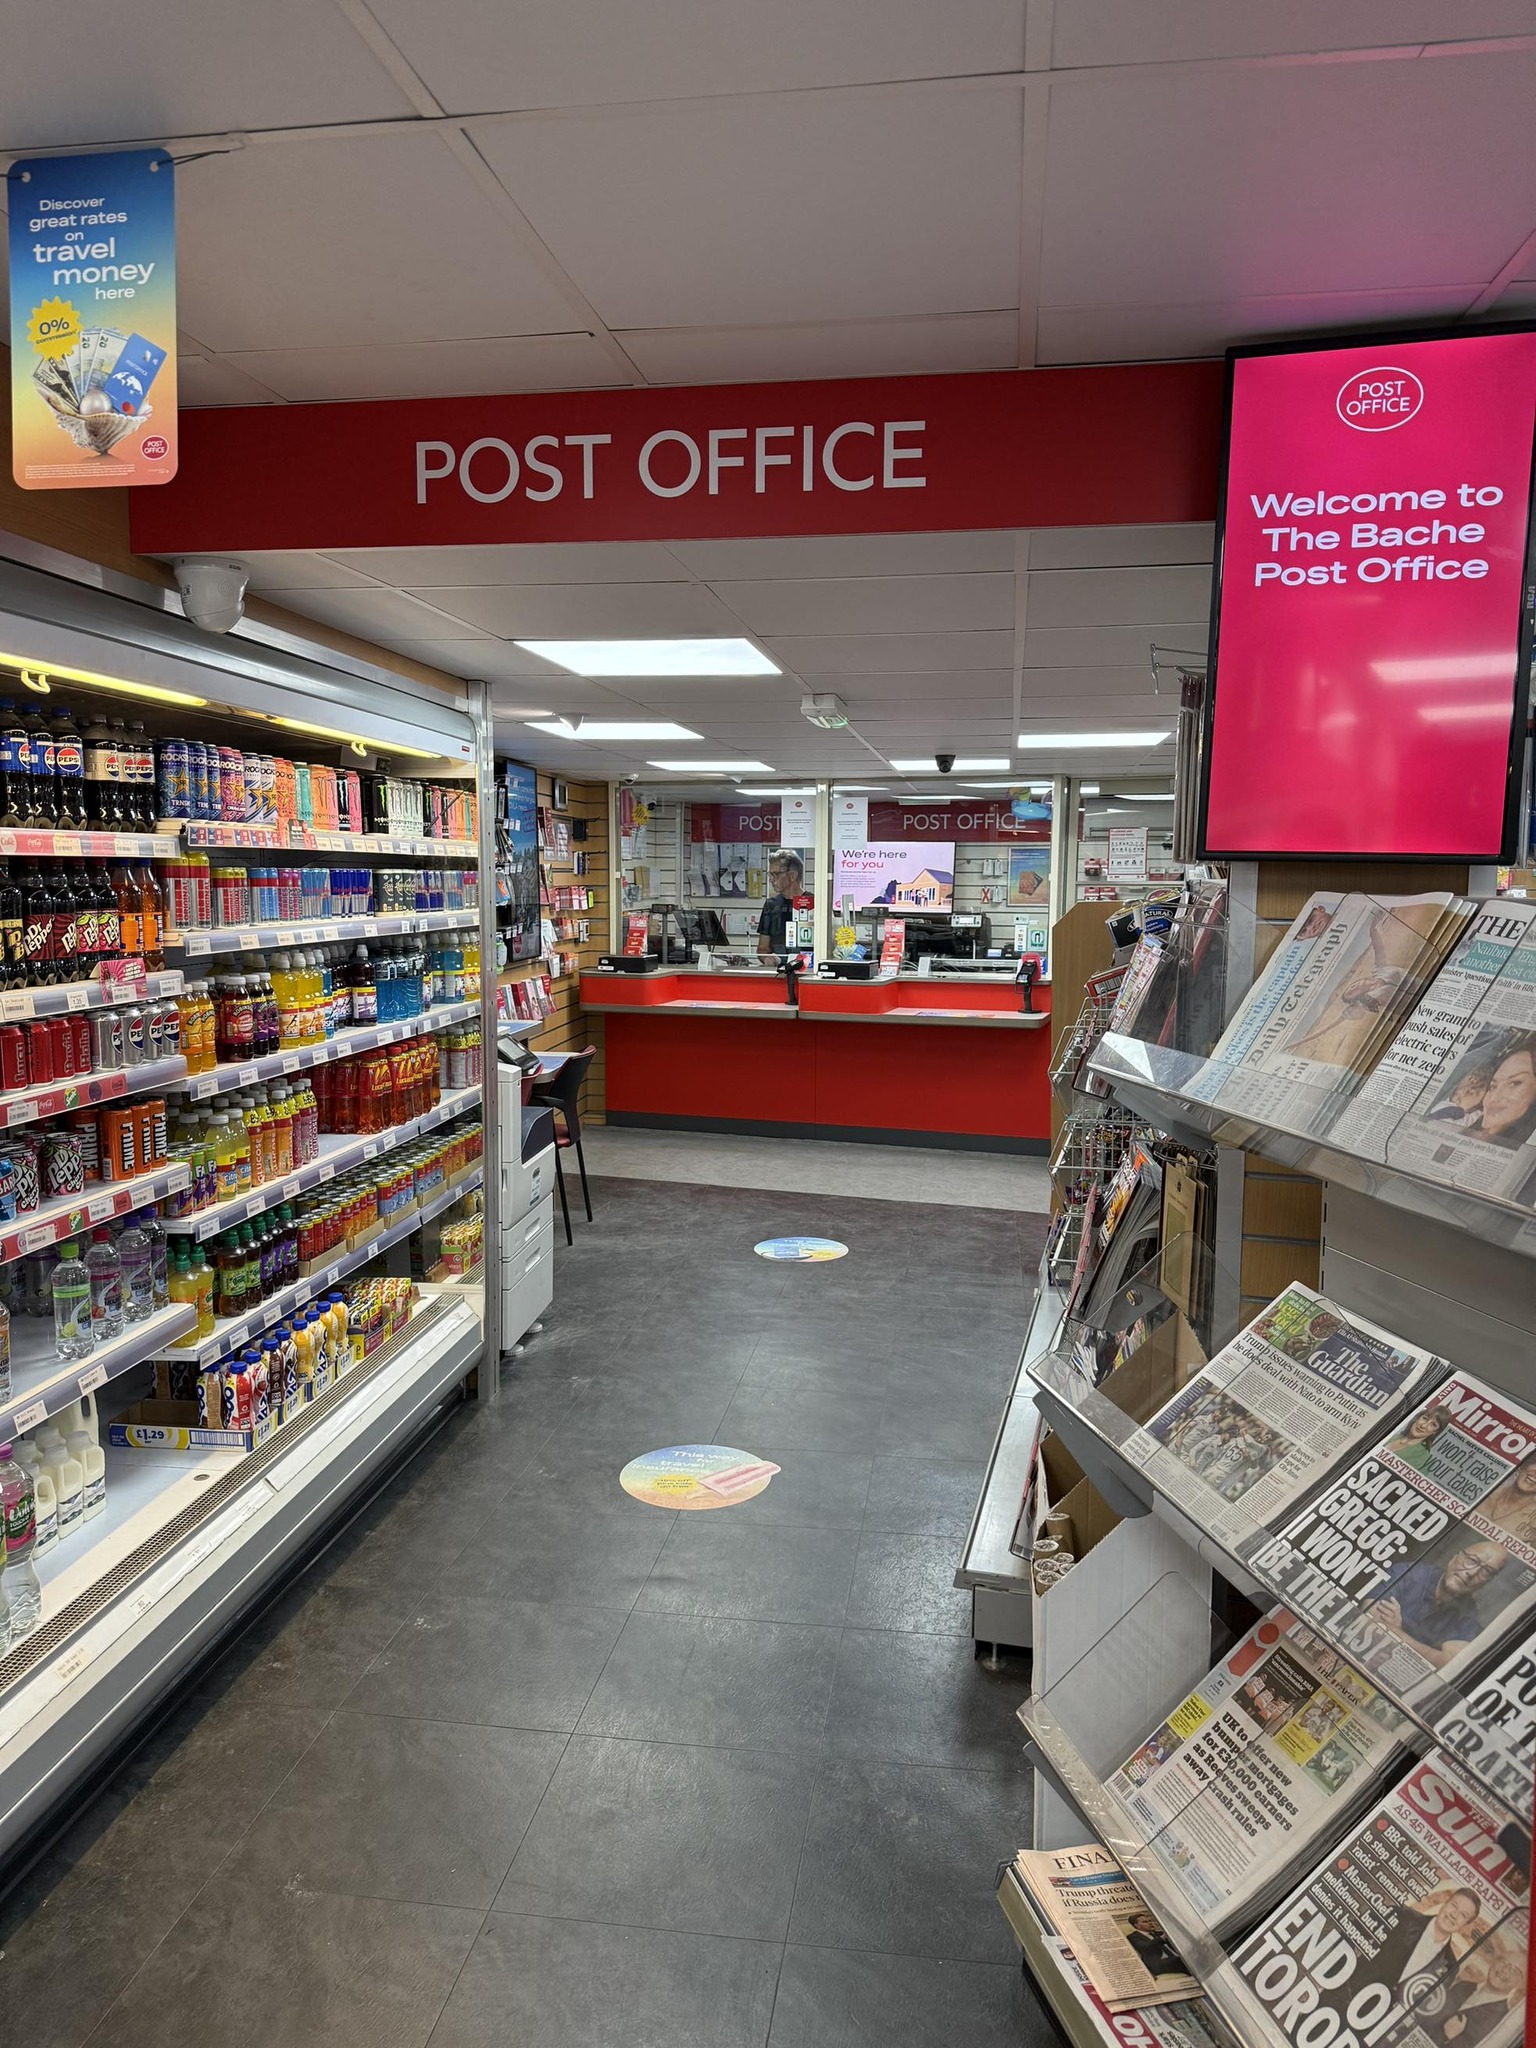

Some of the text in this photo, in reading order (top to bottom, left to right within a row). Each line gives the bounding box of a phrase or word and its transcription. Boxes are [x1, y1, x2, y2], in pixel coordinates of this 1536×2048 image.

[29, 211, 128, 231] great rates
[39, 198, 105, 211] Discover
[33, 238, 116, 263] travel
[64, 231, 84, 241] on
[53, 263, 155, 286] money
[95, 286, 135, 300] here
[39, 317, 70, 336] 0%
[1359, 380, 1406, 398] POST
[1346, 397, 1410, 416] OFFICE
[143, 446, 165, 455] OFFICE
[146, 440, 164, 448] POST
[416, 421, 926, 504] POST OFFICE
[1250, 483, 1504, 519] Welcome to
[1262, 519, 1485, 552] The Bache
[1254, 555, 1489, 587] Post Office
[739, 815, 781, 831] POST
[903, 813, 1026, 830] POST OFFICE
[841, 860, 884, 870] for you
[842, 850, 907, 859] We're here
[23, 918, 53, 956] Pepper
[30, 921, 42, 938] Dr
[1476, 915, 1527, 939] THE
[1463, 956, 1500, 972] another
[1244, 942, 1302, 1026] is the captain
[1246, 1017, 1290, 1065] Daily
[1281, 923, 1348, 1013] Telegraph
[1402, 1021, 1475, 1046] push sales of
[1414, 1004, 1481, 1030] New grant to
[1384, 1048, 1398, 1061] for
[1398, 1051, 1420, 1067] net
[1419, 1059, 1446, 1075] zero
[1395, 1034, 1458, 1060] electric cars
[76, 1123, 97, 1170] PRIME
[122, 1123, 135, 1171] PRIME
[153, 1113, 167, 1159] PRIME
[256, 1138, 265, 1183] GLUCOSE
[341, 1353, 351, 1367] £1.29
[1242, 1332, 1368, 1418] Trump issues warning to Putin as
[1330, 1347, 1370, 1376] The
[316, 1374, 328, 1389] £1.29
[1232, 1341, 1362, 1430] he does deal with Nato to arm Kyiv
[1307, 1350, 1389, 1407] Guardian
[1438, 1383, 1456, 1400] DAILY
[287, 1396, 298, 1411] £1.29
[136, 1429, 164, 1440] £1.29
[258, 1423, 270, 1438] £1.29
[672, 1451, 704, 1459] This
[1431, 1432, 1499, 1486] I won't raise
[1448, 1429, 1508, 1469] RACHEL REEVES EXCLUSIVE
[1419, 1453, 1453, 1480] your
[1447, 1469, 1483, 1501] taxes
[1347, 1461, 1449, 1542] SACKED
[1376, 1449, 1449, 1503] MASTERCHEF
[1447, 1498, 1501, 1542] SCANDAL
[1318, 1488, 1408, 1568] GREGG:
[1286, 1512, 1392, 1601] I WON'T
[1256, 1540, 1393, 1662] BE THE LAST
[1466, 1689, 1522, 1734] OF
[1220, 1713, 1291, 1787] UK to offer new
[1201, 1732, 1220, 1751] for
[1214, 1748, 1258, 1792] £30,000
[1251, 1789, 1294, 1831] earners
[1209, 1722, 1252, 1765] bumper
[1245, 1762, 1299, 1817] mortgages
[1180, 1753, 1209, 1783] away
[1205, 1779, 1236, 1810] crash
[1229, 1807, 1259, 1837] rules
[1192, 1743, 1206, 1757] as
[1202, 1754, 1240, 1793] Reeves
[1232, 1791, 1272, 1831] sweeps
[1405, 1773, 1508, 1872] Sun
[1468, 1809, 1489, 1829] THE
[1350, 1842, 1409, 1903] 'racist' remark
[1361, 1831, 1427, 1898] to step back over
[1383, 1826, 1441, 1885] BBC told John
[1394, 1804, 1503, 1910] AS 45 WALLACE RAPS
[1058, 1885, 1096, 1901] Trump
[1063, 1892, 1135, 1908] if Russia does
[1321, 1872, 1388, 1941] meltdown.. but he
[1341, 1866, 1400, 1926] MasterChef in
[1309, 1882, 1381, 1958] denies it happened
[1273, 1901, 1357, 1989] END
